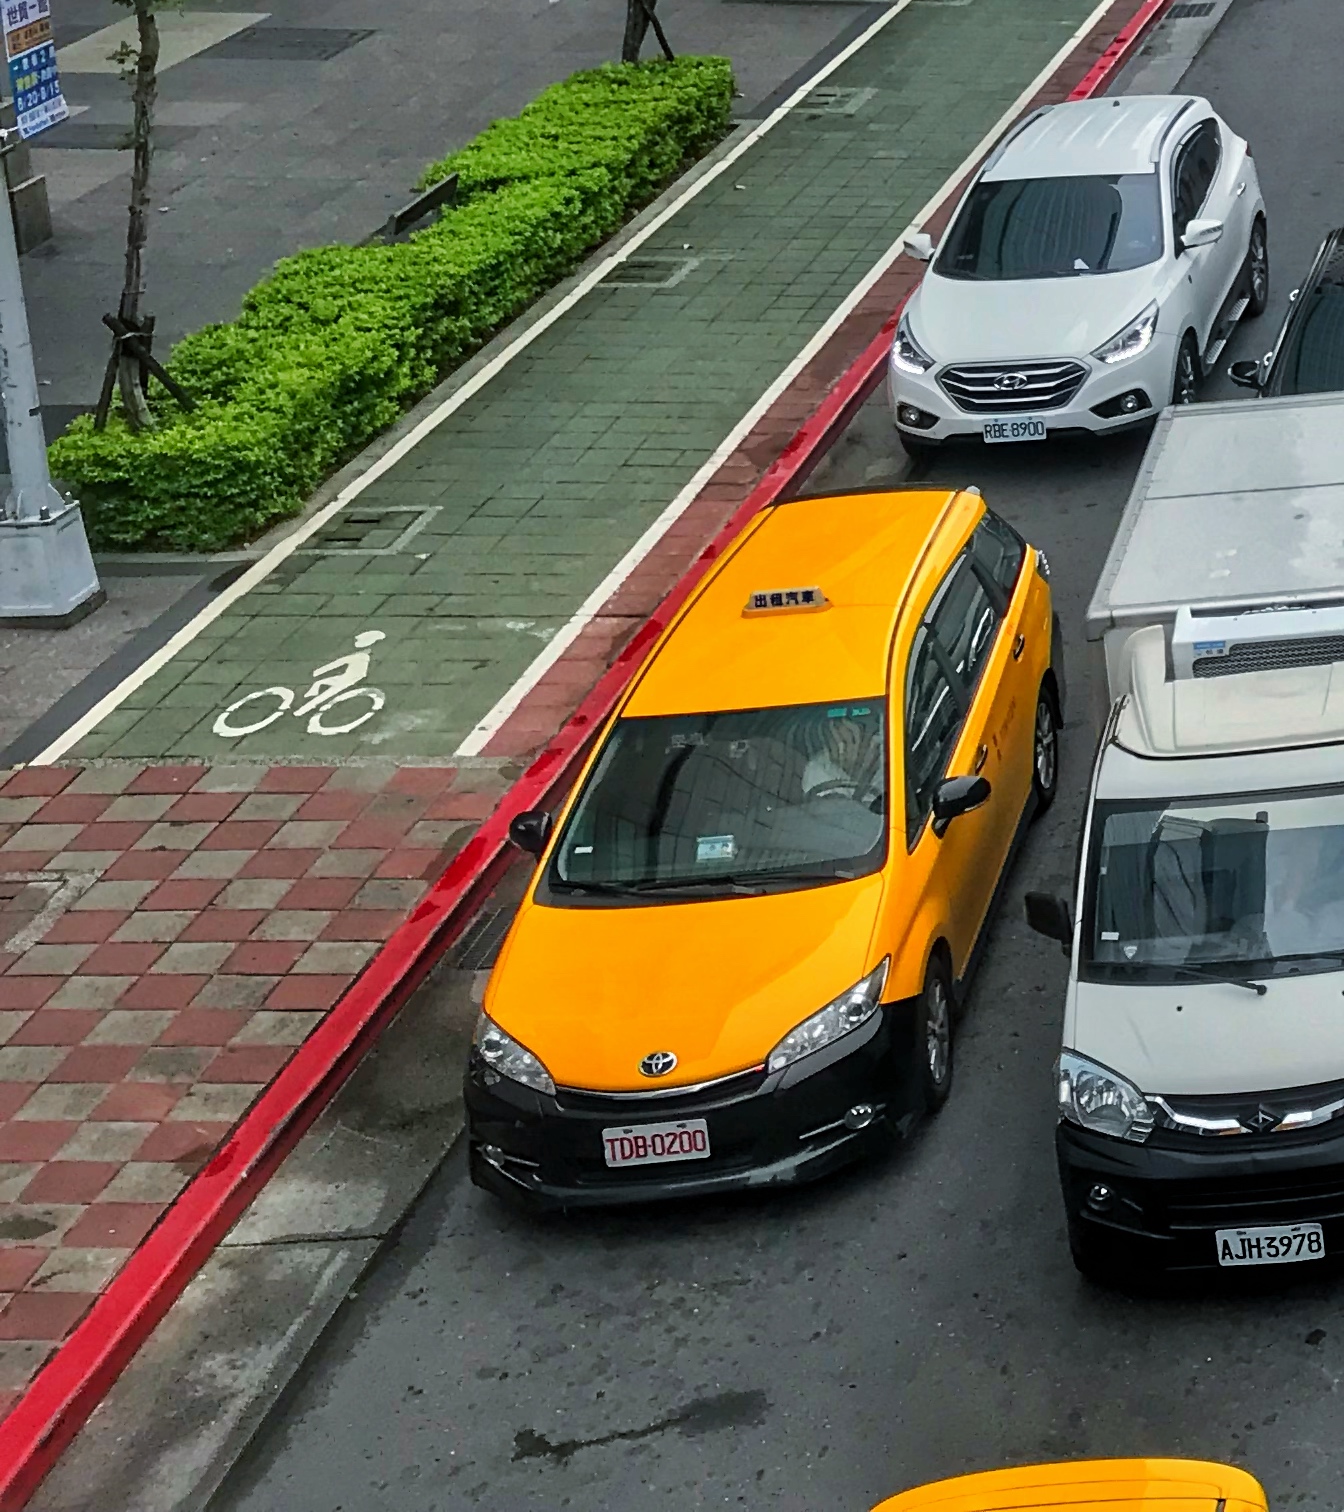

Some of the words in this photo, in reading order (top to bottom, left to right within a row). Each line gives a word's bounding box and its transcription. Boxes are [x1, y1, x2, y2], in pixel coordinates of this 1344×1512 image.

[983, 420, 1045, 439] RBE-8900
[754, 590, 814, 608] 出租汽車
[605, 1129, 707, 1162] TDB-0200
[1220, 1230, 1323, 1261] AJH-3978
